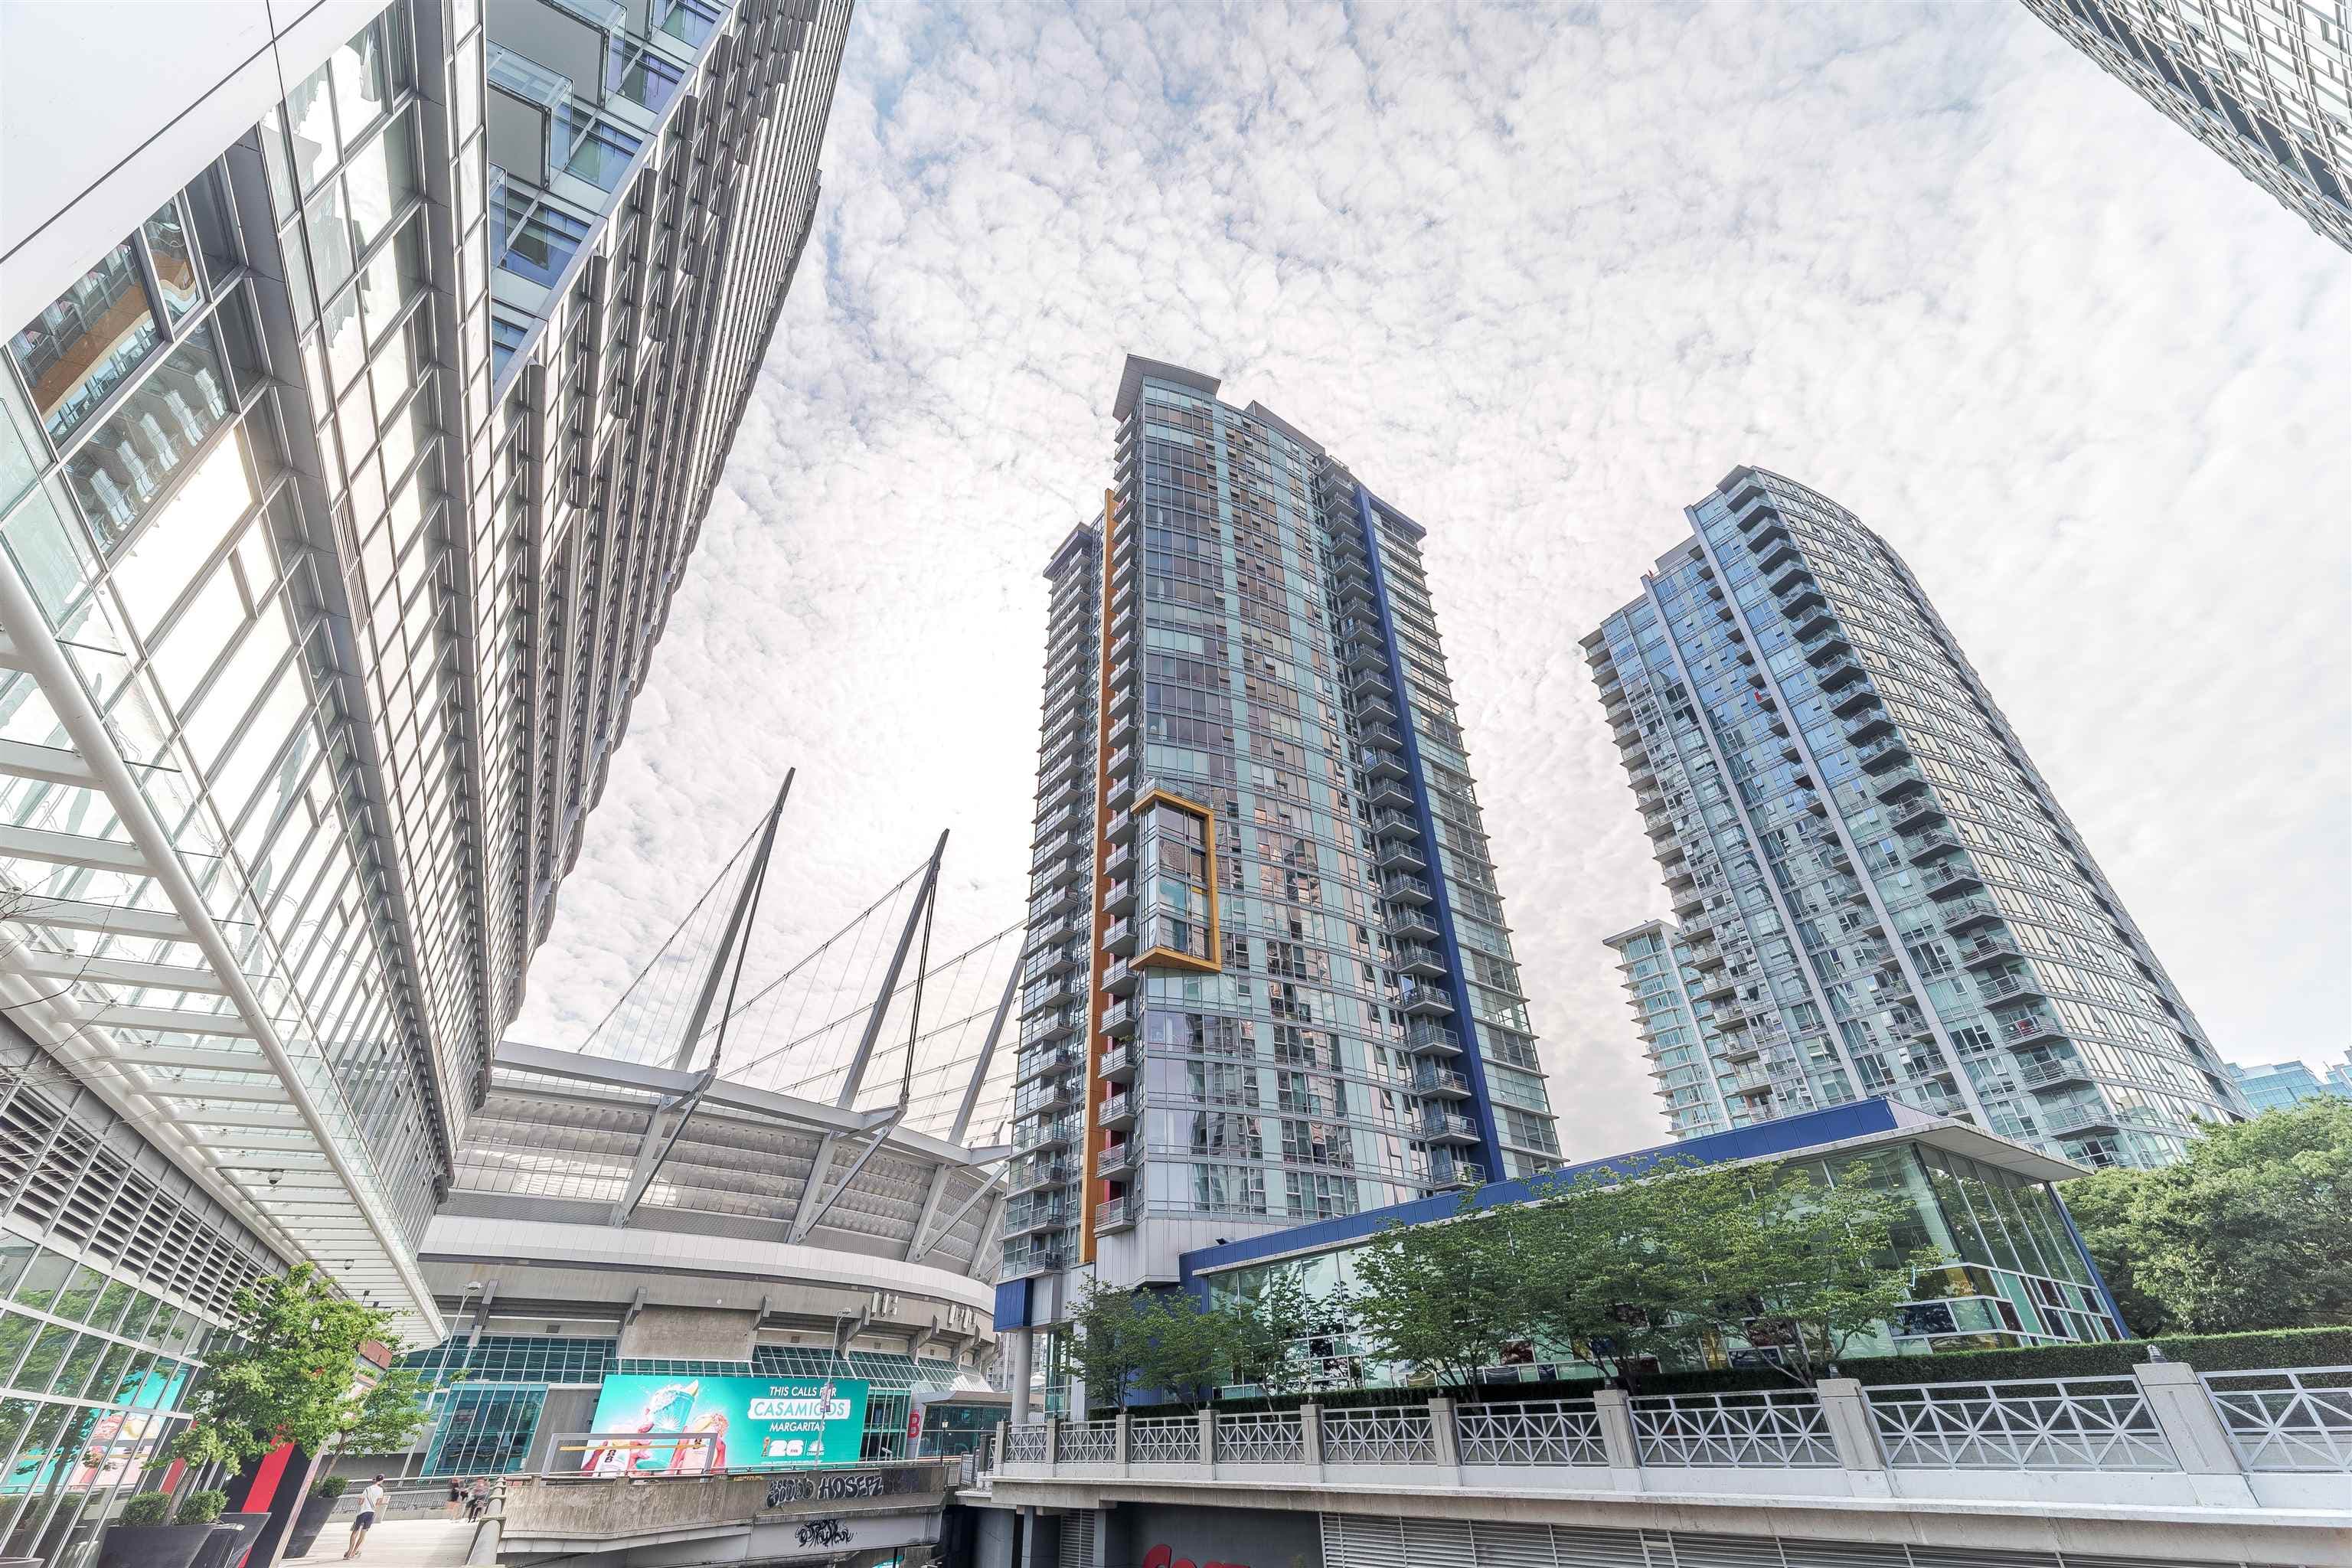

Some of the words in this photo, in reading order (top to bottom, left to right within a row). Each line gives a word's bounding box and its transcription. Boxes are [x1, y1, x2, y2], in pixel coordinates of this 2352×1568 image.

[769, 1387, 789, 1396] THIS
[791, 1387, 818, 1396] CALLS
[819, 1387, 837, 1396] FR
[769, 1421, 825, 1432] MARGARITAS
[907, 1413, 920, 1438] B
